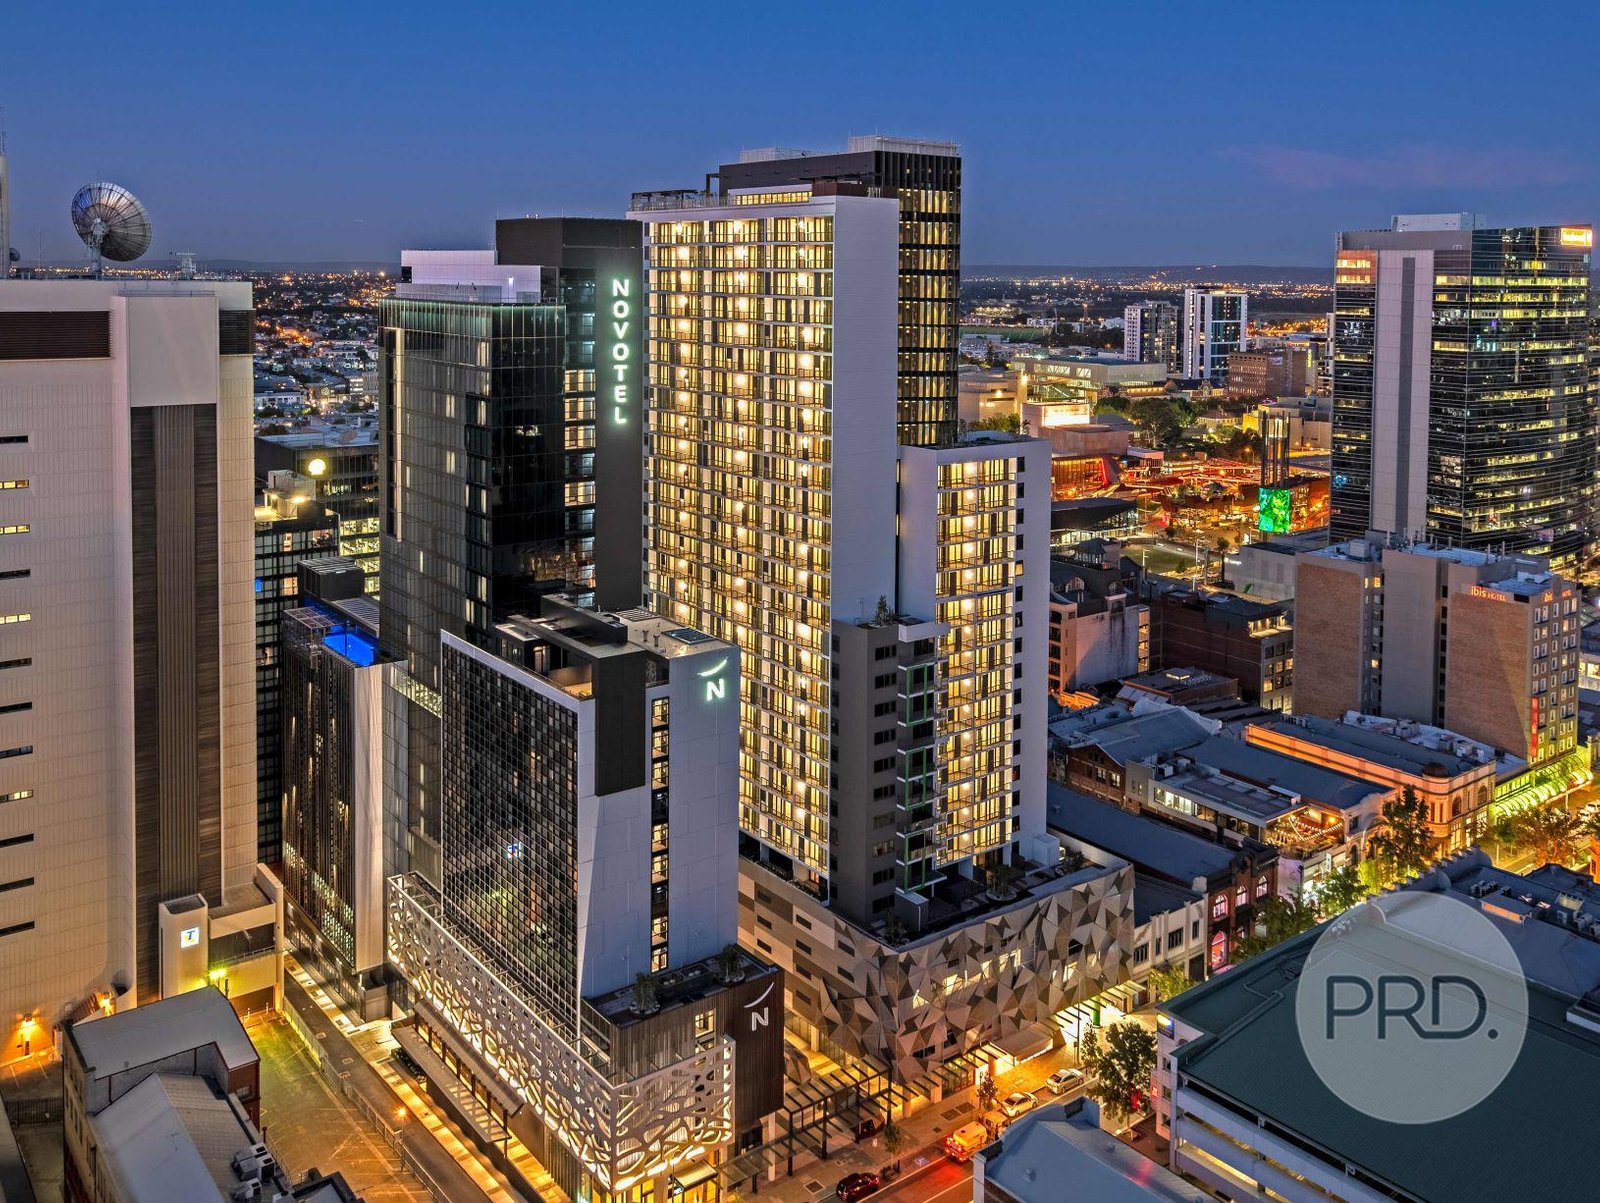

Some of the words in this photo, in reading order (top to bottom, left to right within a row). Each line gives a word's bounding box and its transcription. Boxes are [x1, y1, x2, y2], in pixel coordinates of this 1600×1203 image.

[612, 278, 630, 425] NOVOTEL
[1471, 586, 1487, 598] ibis
[1487, 592, 1506, 602] HOTEL
[706, 678, 725, 701] N
[751, 1006, 769, 1031] N
